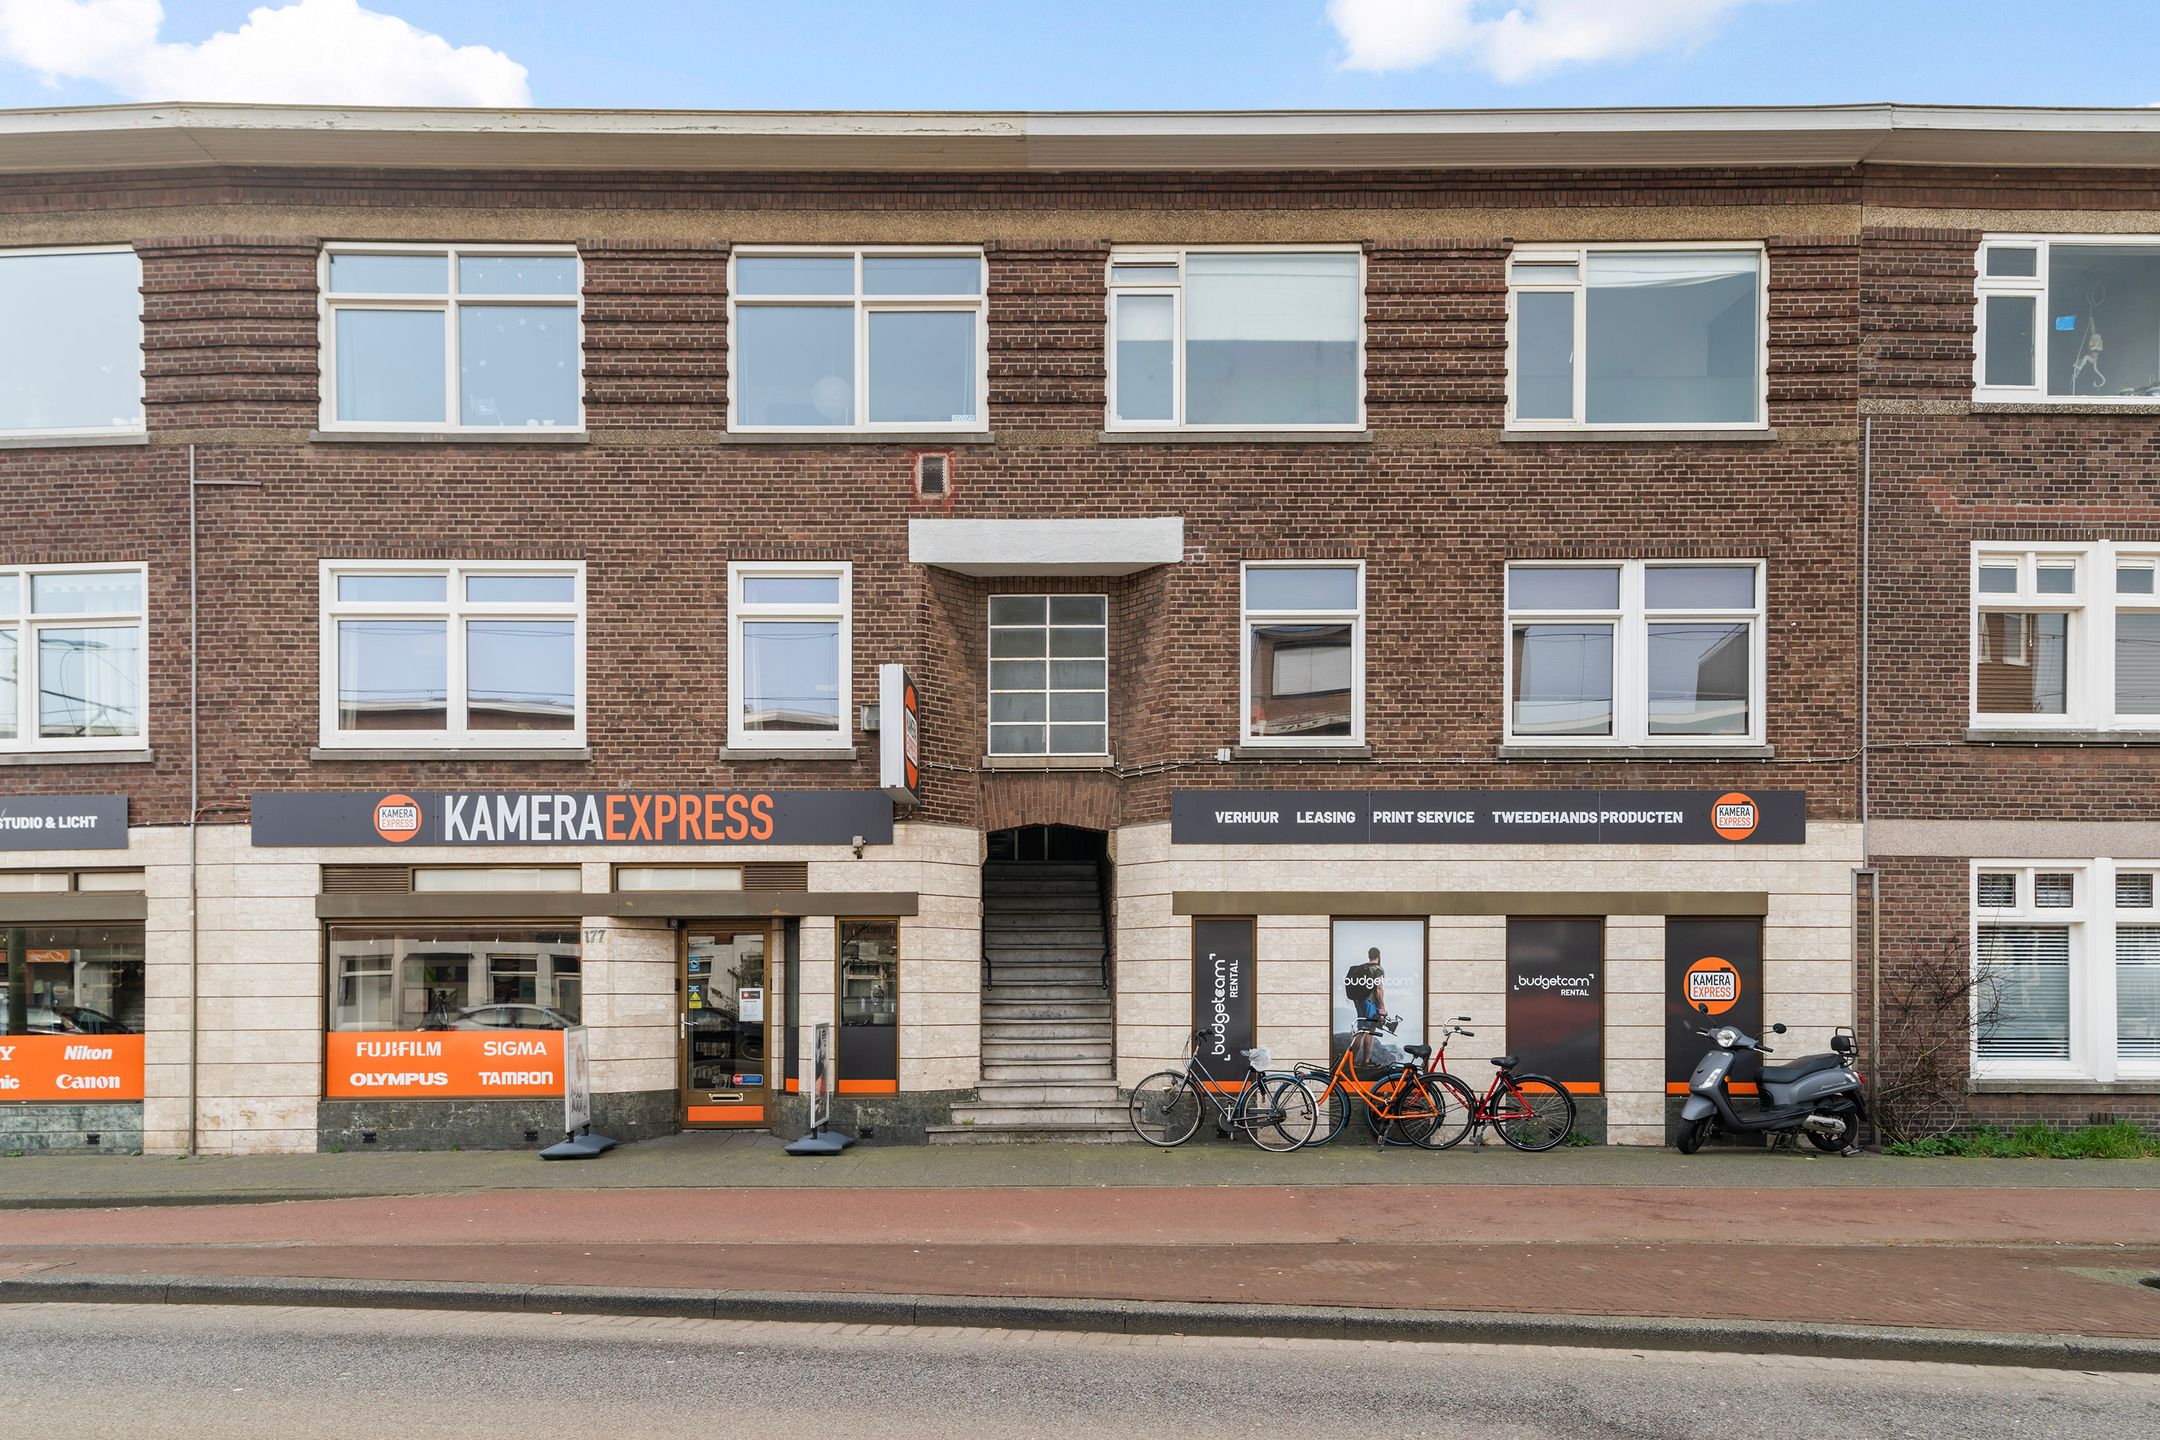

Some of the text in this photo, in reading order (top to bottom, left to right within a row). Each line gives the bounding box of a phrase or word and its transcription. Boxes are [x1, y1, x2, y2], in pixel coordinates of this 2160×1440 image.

[381, 808, 414, 818] KAMERA
[1215, 811, 1683, 824] VERHUUR LEASING PRINT SERVICE TWEEDEHANDS PRODUCTEN
[1719, 806, 1751, 817] KAMERA
[45, 816, 56, 829] &
[58, 815, 98, 829] LICHT
[381, 818, 414, 828] EXPRESS
[1719, 817, 1751, 827] EXPRESS
[584, 928, 607, 944] 177
[1229, 959, 1239, 998] RENTAL
[1518, 974, 1590, 990] budgetcam
[1693, 974, 1731, 986] KAMERA
[1693, 986, 1732, 998] EXPRESS
[1211, 959, 1230, 1055] budgetcam
[64, 1045, 113, 1060] Nikon
[356, 1041, 442, 1057] FUJIFILM
[483, 1041, 547, 1056] SIGMA
[56, 1073, 120, 1089] Canon
[350, 1072, 449, 1086] OLYMPUS
[478, 1071, 553, 1085] TAMRON
